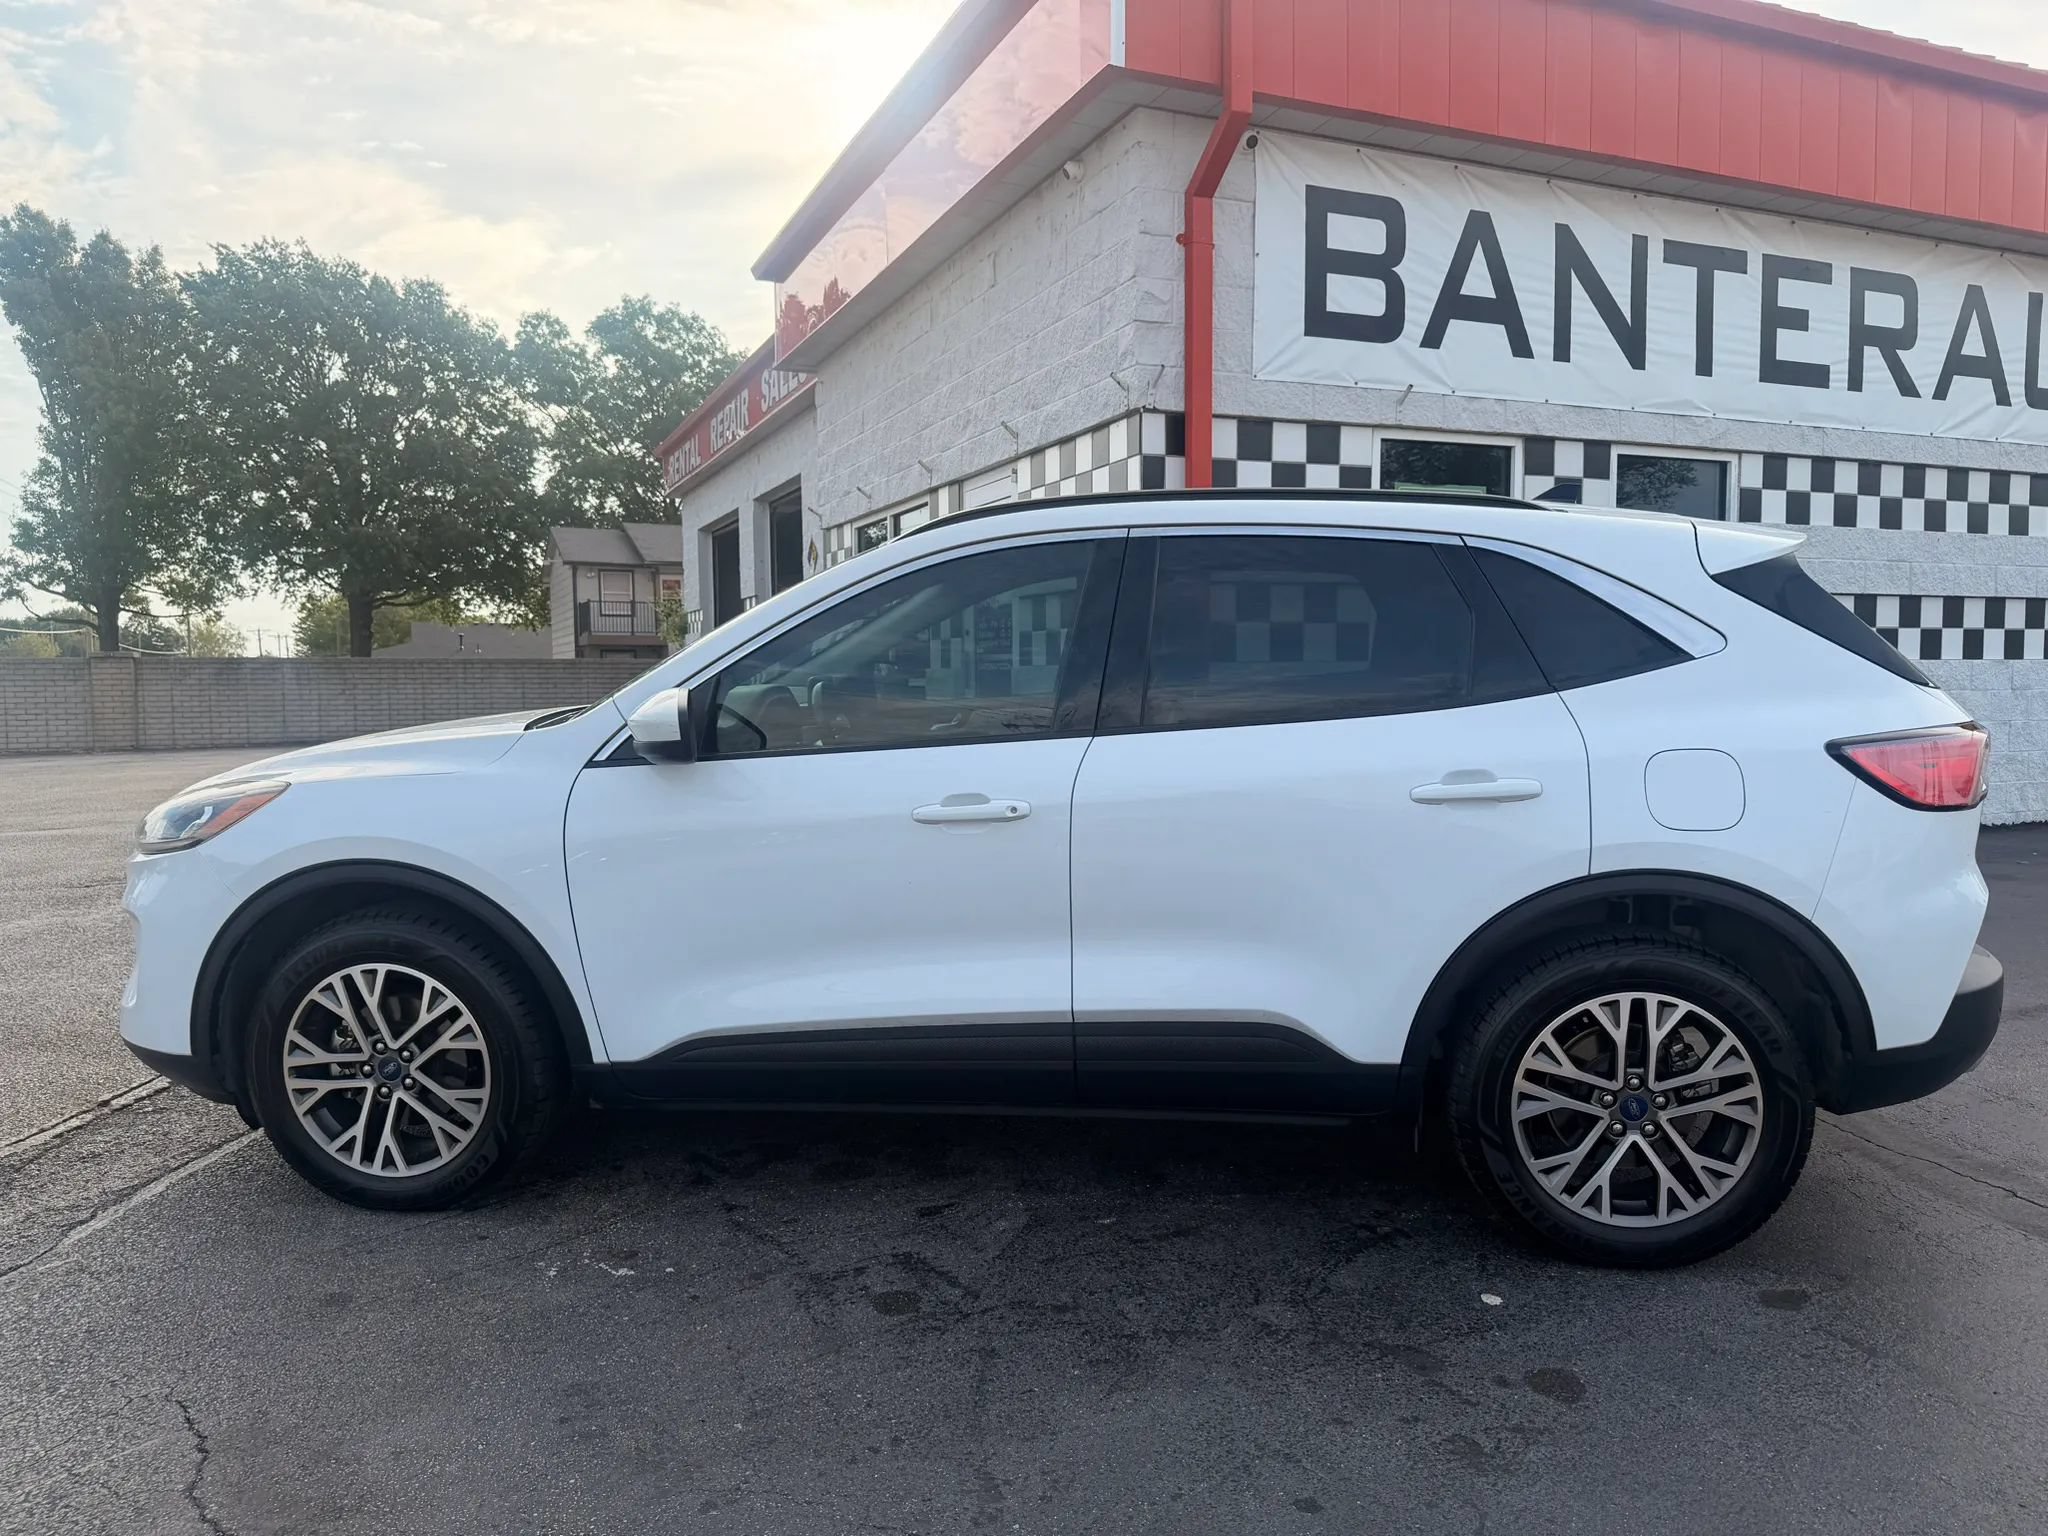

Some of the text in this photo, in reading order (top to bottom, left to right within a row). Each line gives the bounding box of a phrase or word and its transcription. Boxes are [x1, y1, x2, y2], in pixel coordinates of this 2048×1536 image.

[667, 369, 807, 487] RENTAL REPAIR SAL
